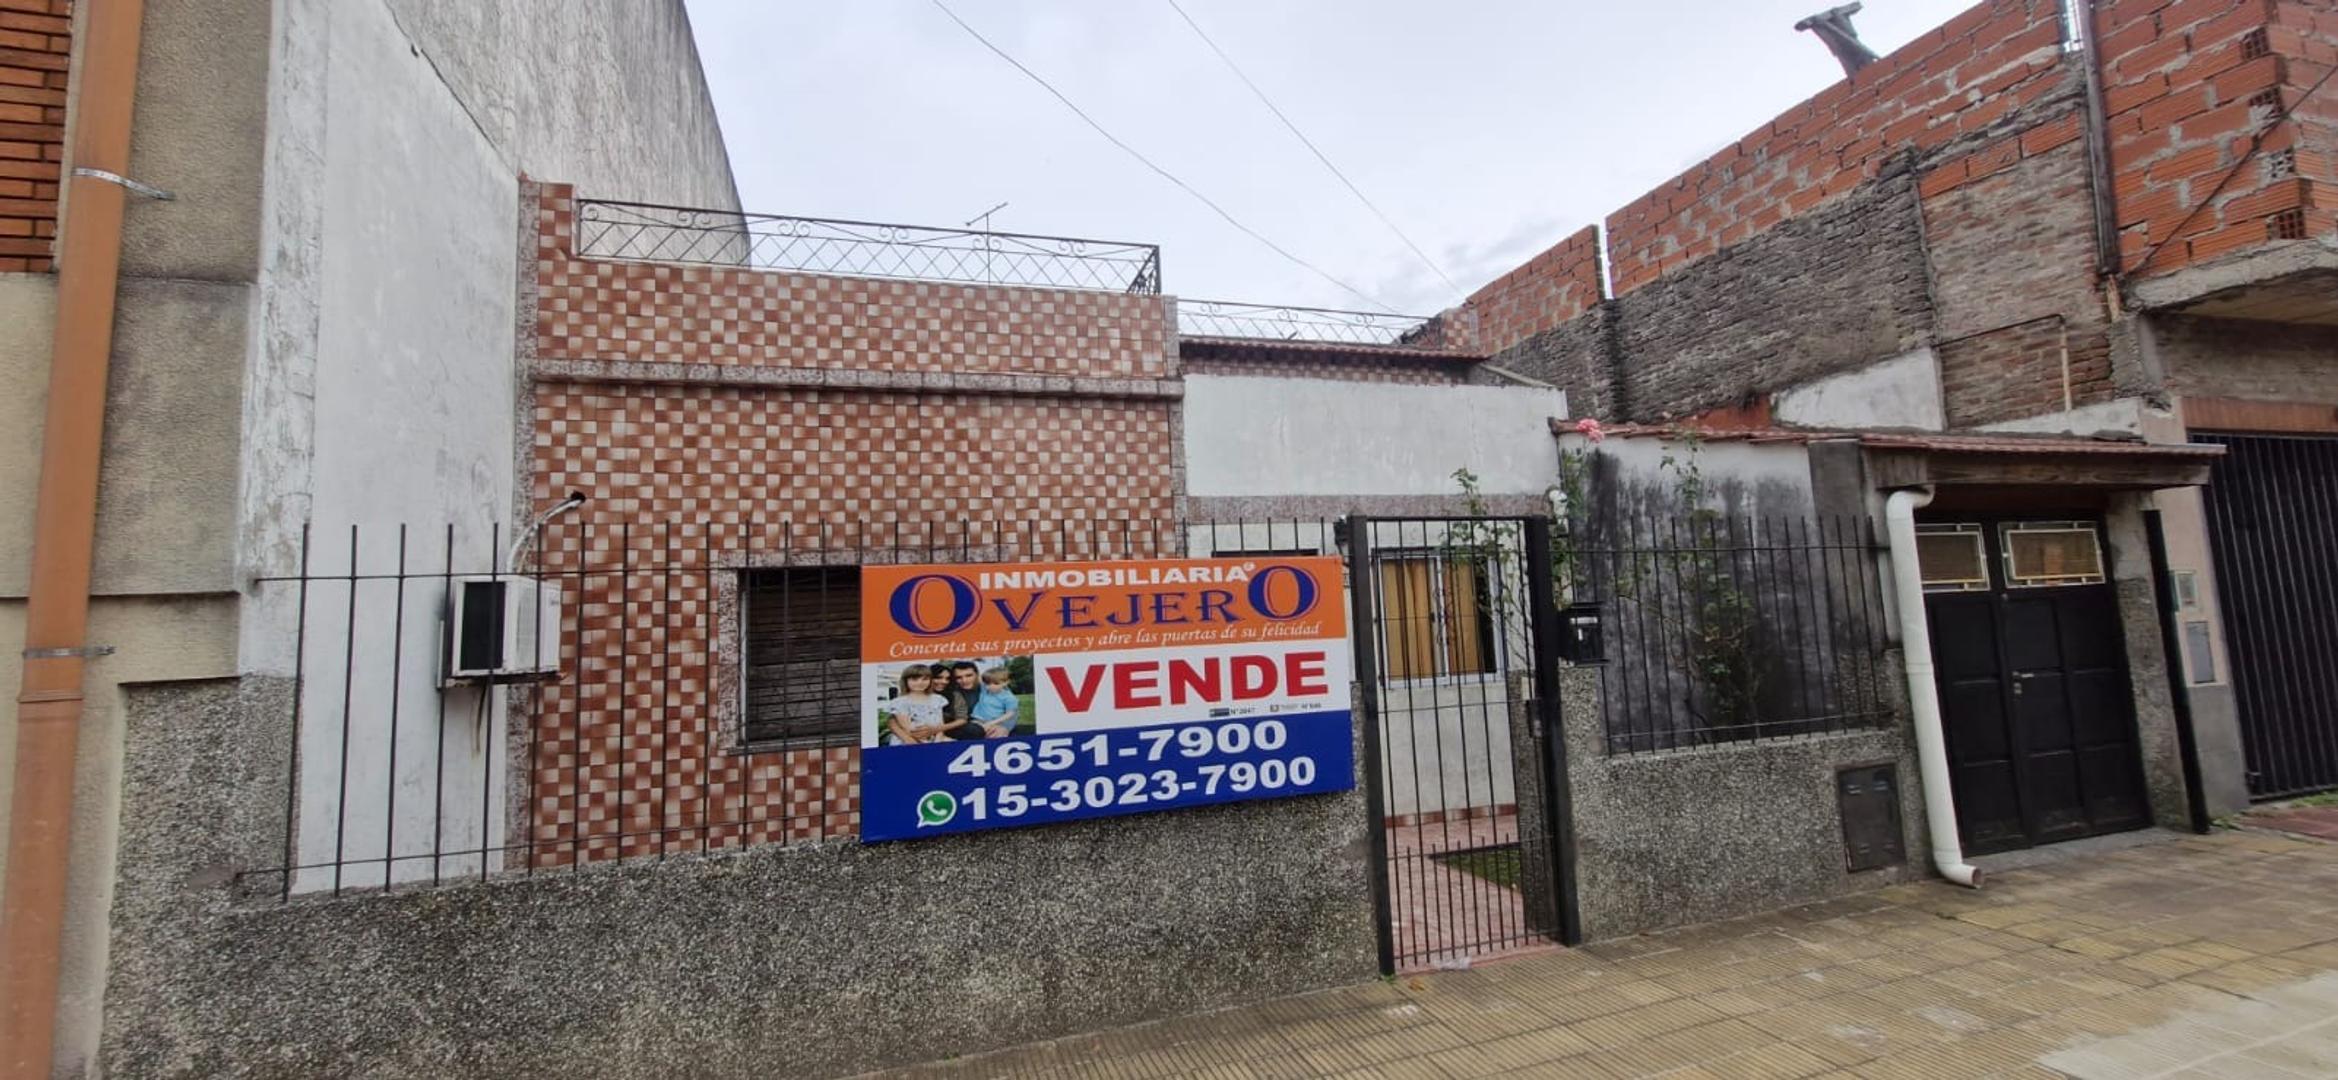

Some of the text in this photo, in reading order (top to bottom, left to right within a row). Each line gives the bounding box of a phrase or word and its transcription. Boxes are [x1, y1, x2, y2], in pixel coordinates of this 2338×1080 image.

[889, 565, 1320, 638] OVEJERO
[889, 622, 1323, 658] Concreta sus proyectos y abre las puertas de su felicidad
[1045, 651, 1329, 714] VENDE
[948, 720, 1288, 777] 4651-7900
[961, 756, 1317, 821] 15-3023-7900
